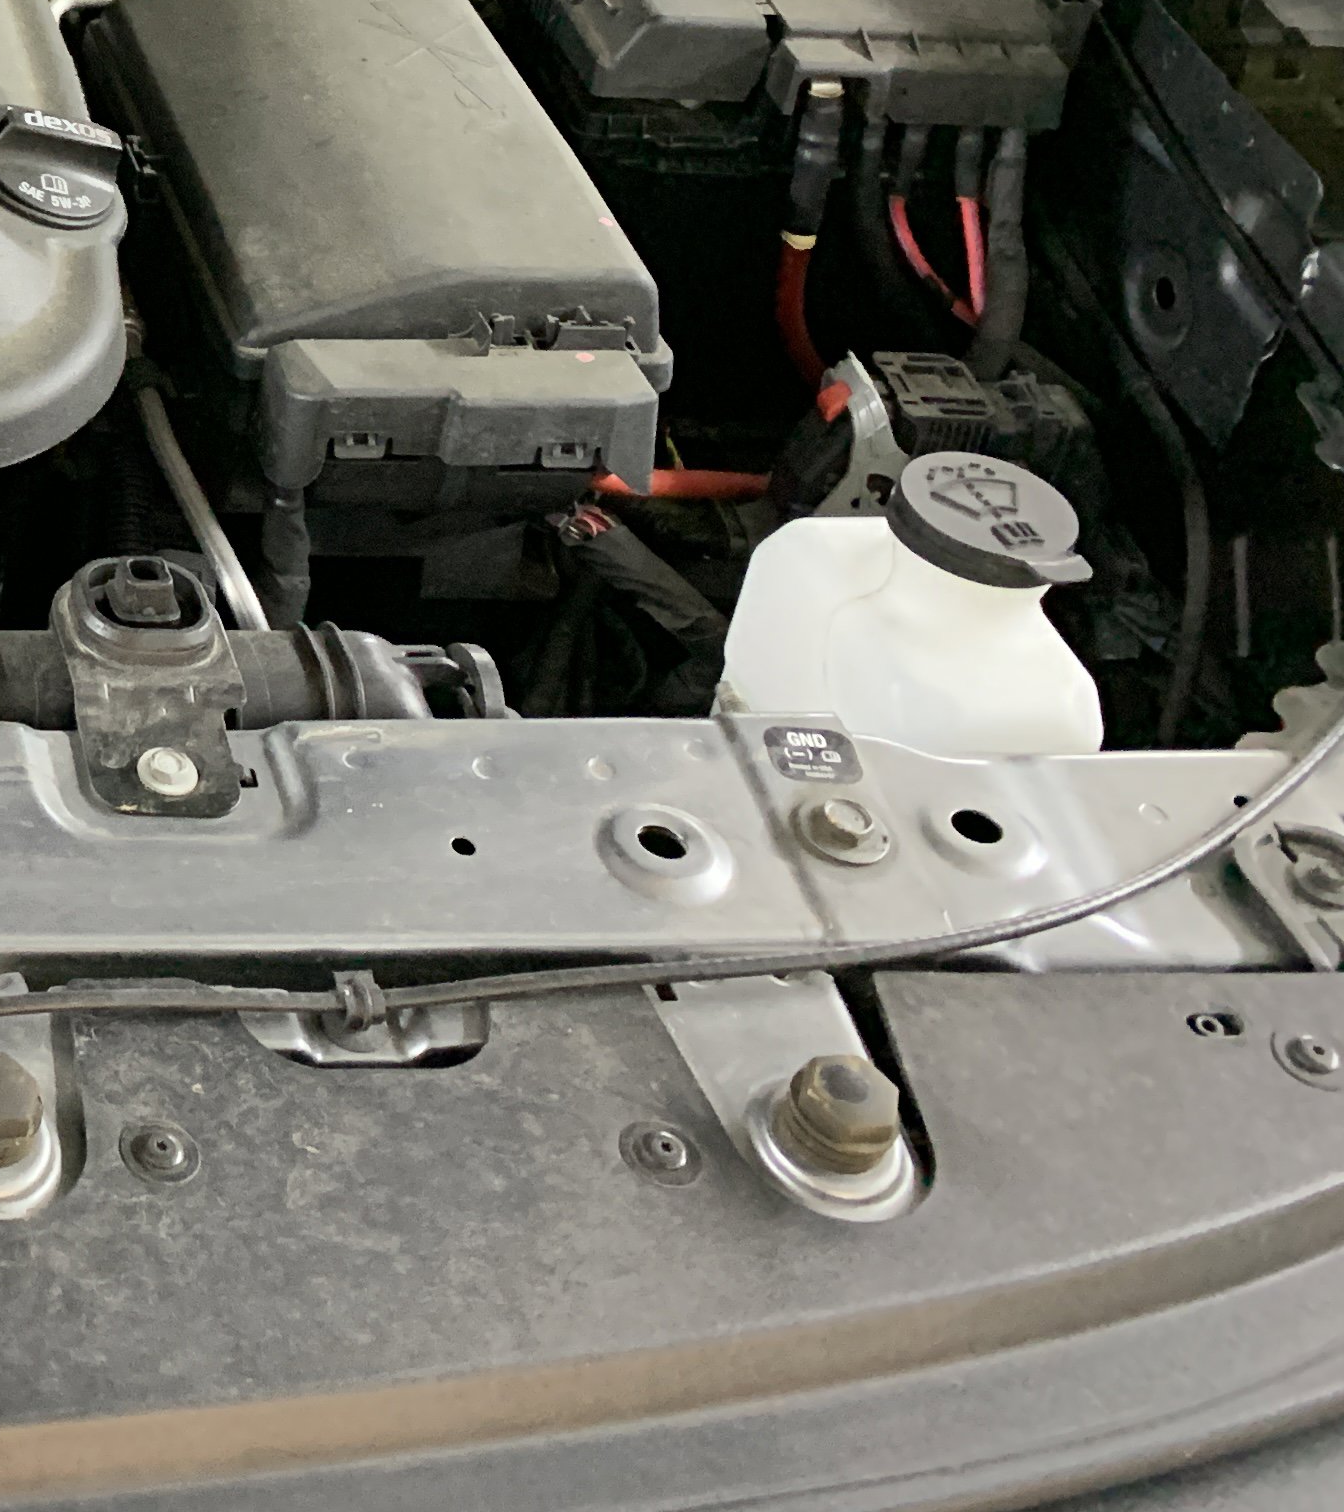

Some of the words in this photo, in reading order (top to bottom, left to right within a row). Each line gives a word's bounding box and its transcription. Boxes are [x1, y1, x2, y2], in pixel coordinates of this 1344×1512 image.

[23, 110, 113, 145] dexos
[18, 180, 45, 202] SAE
[786, 731, 828, 749] GND
